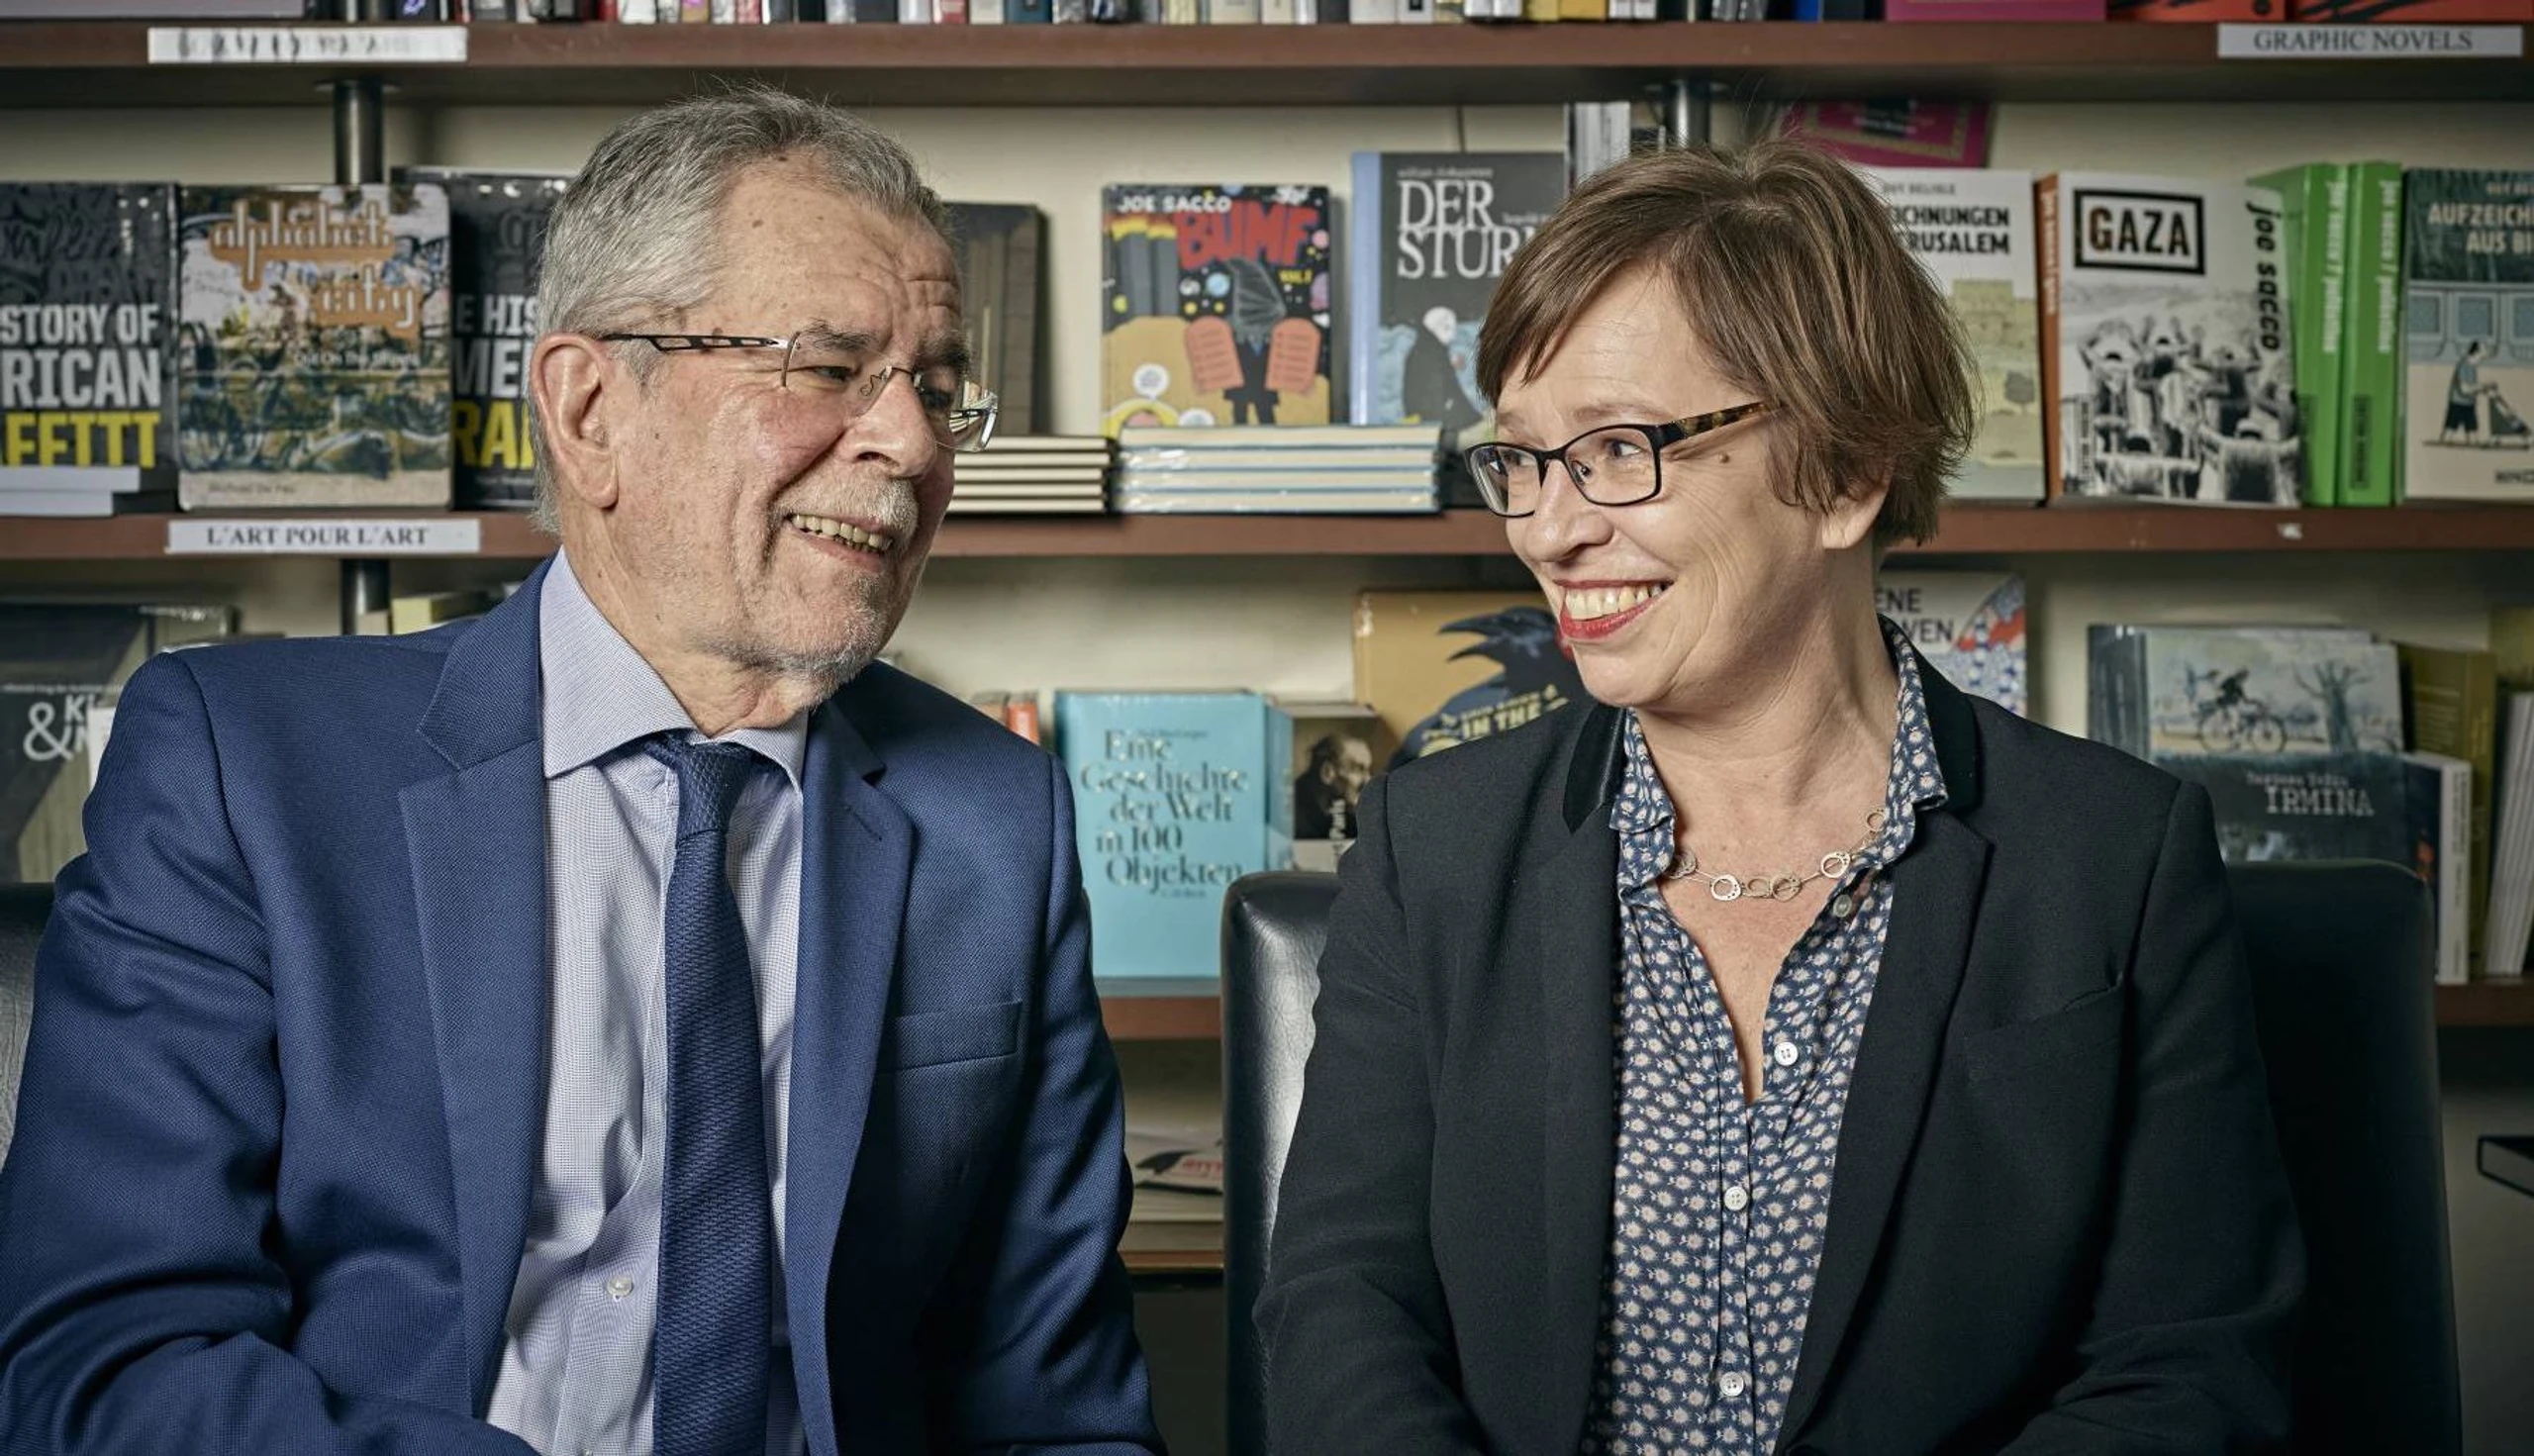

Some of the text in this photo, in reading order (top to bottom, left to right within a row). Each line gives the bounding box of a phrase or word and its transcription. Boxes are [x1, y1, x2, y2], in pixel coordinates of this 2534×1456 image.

[2253, 30, 2474, 51] GRAPHIC NOVELS
[1118, 195, 1232, 214] JOE SACCO
[1397, 178, 1496, 231] DER
[1174, 199, 1319, 271] BUMF
[2088, 206, 2192, 257] GAZA
[2467, 230, 2507, 255] AUS
[1397, 225, 1536, 280] STUR
[2246, 201, 2282, 351] joe sacco
[0, 303, 158, 344] STORY OF
[2, 348, 160, 409] RICAN
[206, 526, 430, 546] L'ART POUR L'ART
[23, 701, 75, 761] &
[1461, 716, 1492, 741] IN
[1081, 761, 1249, 792] Geschichte
[1109, 792, 1233, 823] der Welt
[2264, 785, 2376, 818] IRMINA
[1096, 825, 1183, 853] in 100
[1106, 853, 1243, 895] Objekten
